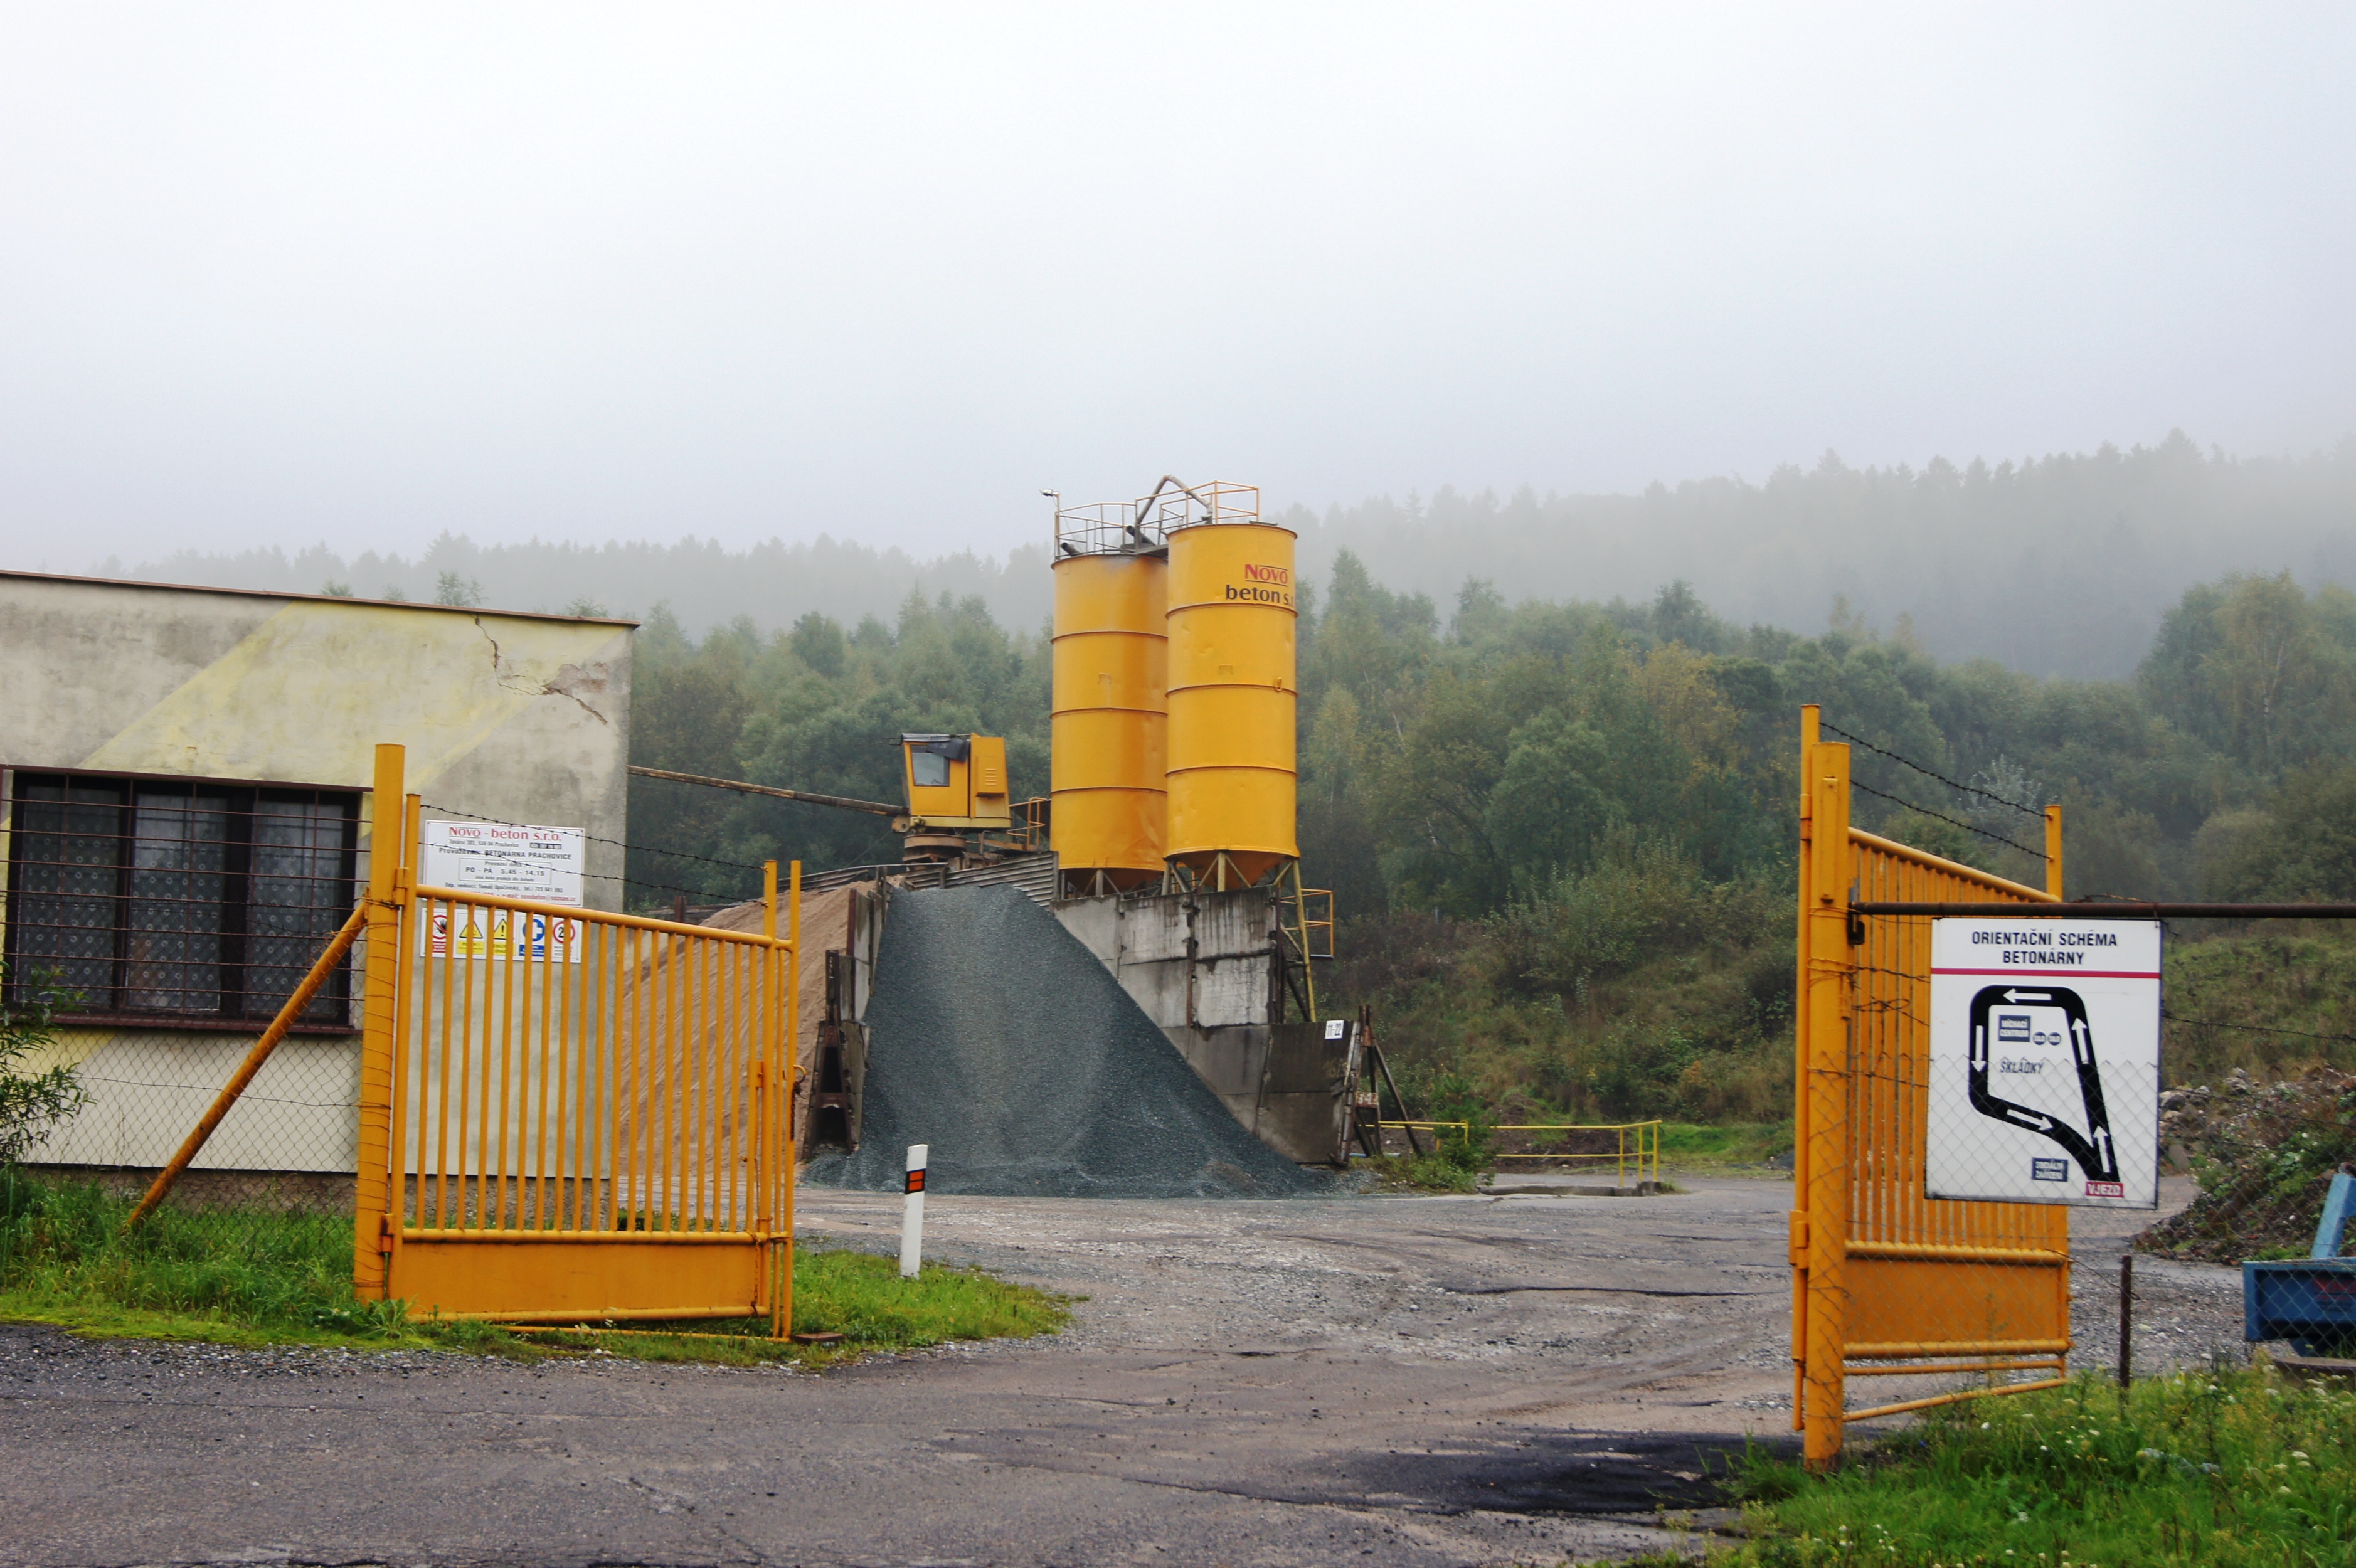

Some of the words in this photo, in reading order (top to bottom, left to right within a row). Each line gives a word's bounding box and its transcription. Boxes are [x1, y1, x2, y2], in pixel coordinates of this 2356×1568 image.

[1226, 585, 1280, 603] beton
[491, 828, 528, 839] beton
[534, 832, 561, 841] s.r.o.
[484, 849, 525, 857] BETONÁRNA
[528, 852, 572, 860] PRACHOVICE
[1971, 928, 2052, 946] ORIENTAČNÍ
[2059, 928, 2118, 946] SCHÉMA
[2002, 947, 2084, 965] BETONÁRNY
[2000, 1029, 2029, 1037] CENTRUM
[2088, 1183, 2121, 1195] VJEZD
